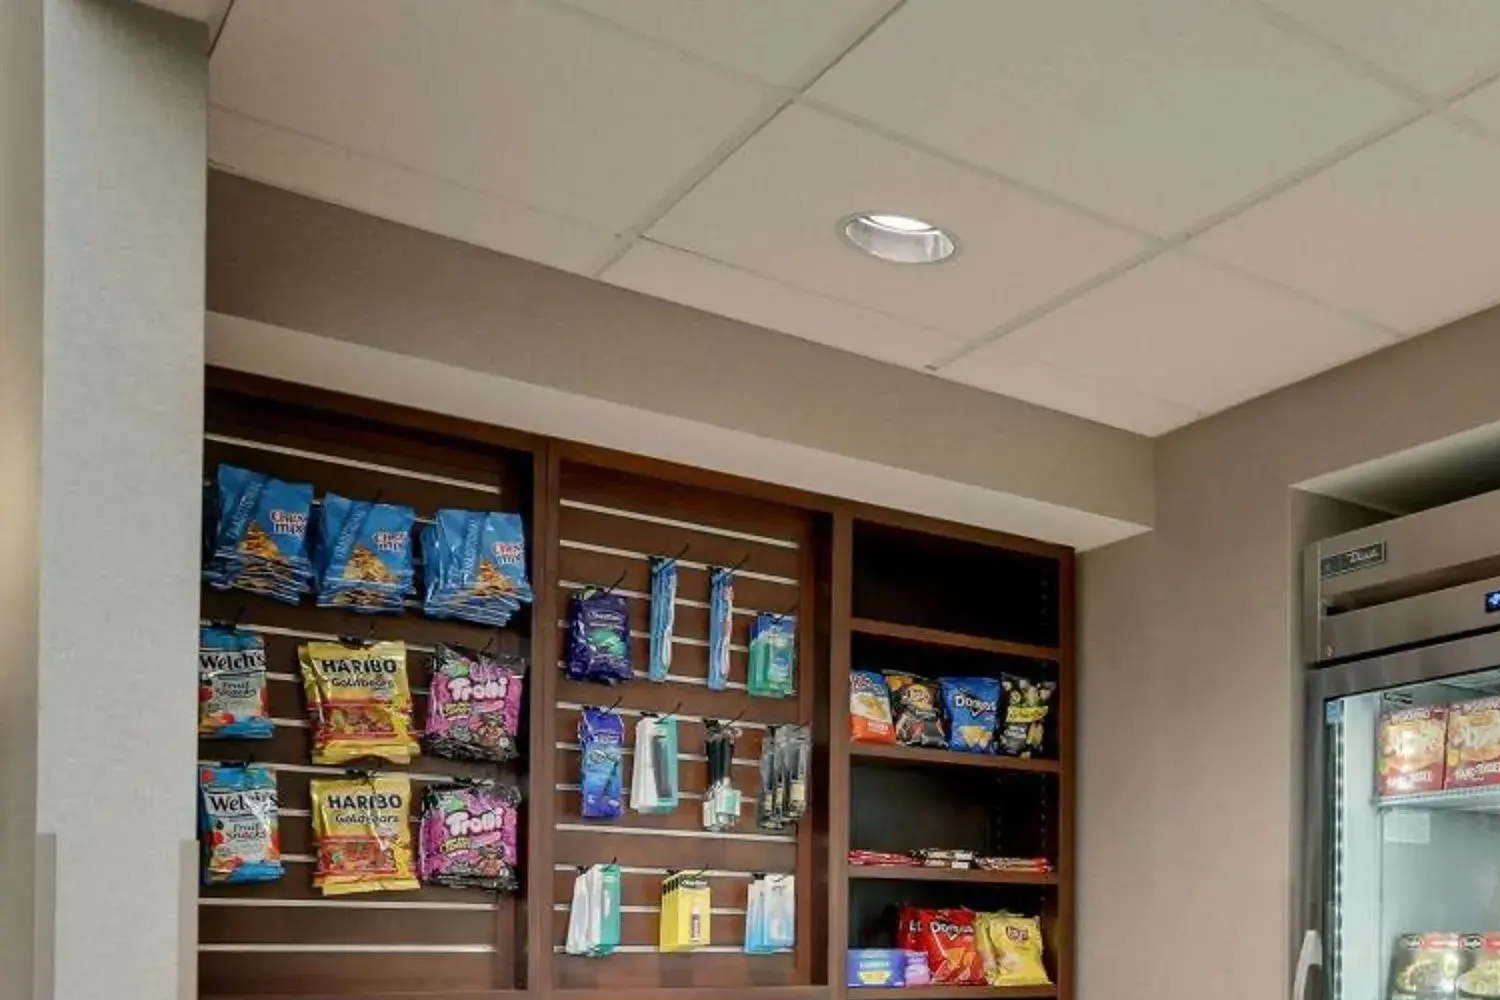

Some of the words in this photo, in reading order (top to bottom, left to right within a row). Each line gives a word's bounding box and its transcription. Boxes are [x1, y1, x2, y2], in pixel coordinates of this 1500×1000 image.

[199, 652, 267, 671] Welch's
[322, 658, 397, 674] HARIBO
[447, 676, 508, 701] Trolli
[327, 794, 403, 809] HARIBO
[445, 806, 504, 837] Trolli
